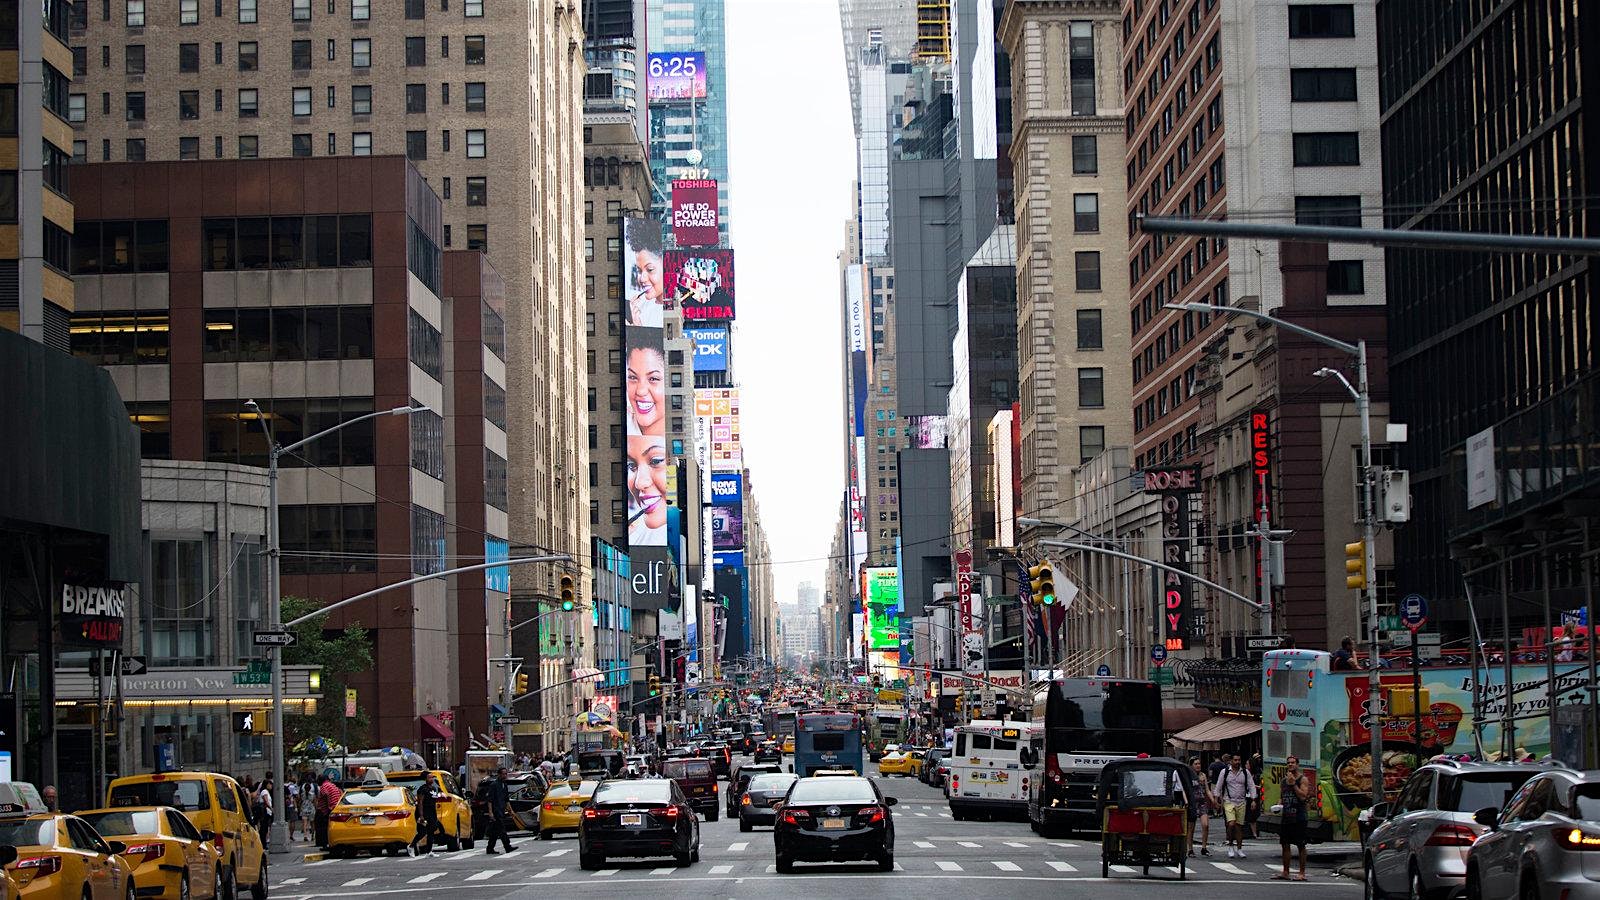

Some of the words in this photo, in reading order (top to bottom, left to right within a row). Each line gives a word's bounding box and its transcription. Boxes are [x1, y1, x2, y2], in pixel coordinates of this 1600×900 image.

[650, 57, 696, 77] 6:25
[680, 168, 709, 180] 2017
[672, 180, 717, 189] TOSHIBA
[680, 203, 695, 211] WE
[696, 203, 709, 211] DO
[674, 210, 716, 220] POWER
[674, 219, 716, 228] STORAGE
[682, 306, 734, 318] SHIBA
[690, 330, 725, 340] Tomor
[854, 323, 861, 336] TO
[1145, 470, 1196, 491] ROSIE
[714, 487, 738, 496] TOUR
[1166, 638, 1183, 650] BAR
[112, 677, 188, 690] heraton
[193, 677, 228, 689] New
[241, 675, 247, 683] W
[250, 674, 261, 683] 53
[990, 676, 1020, 688] ROCK
